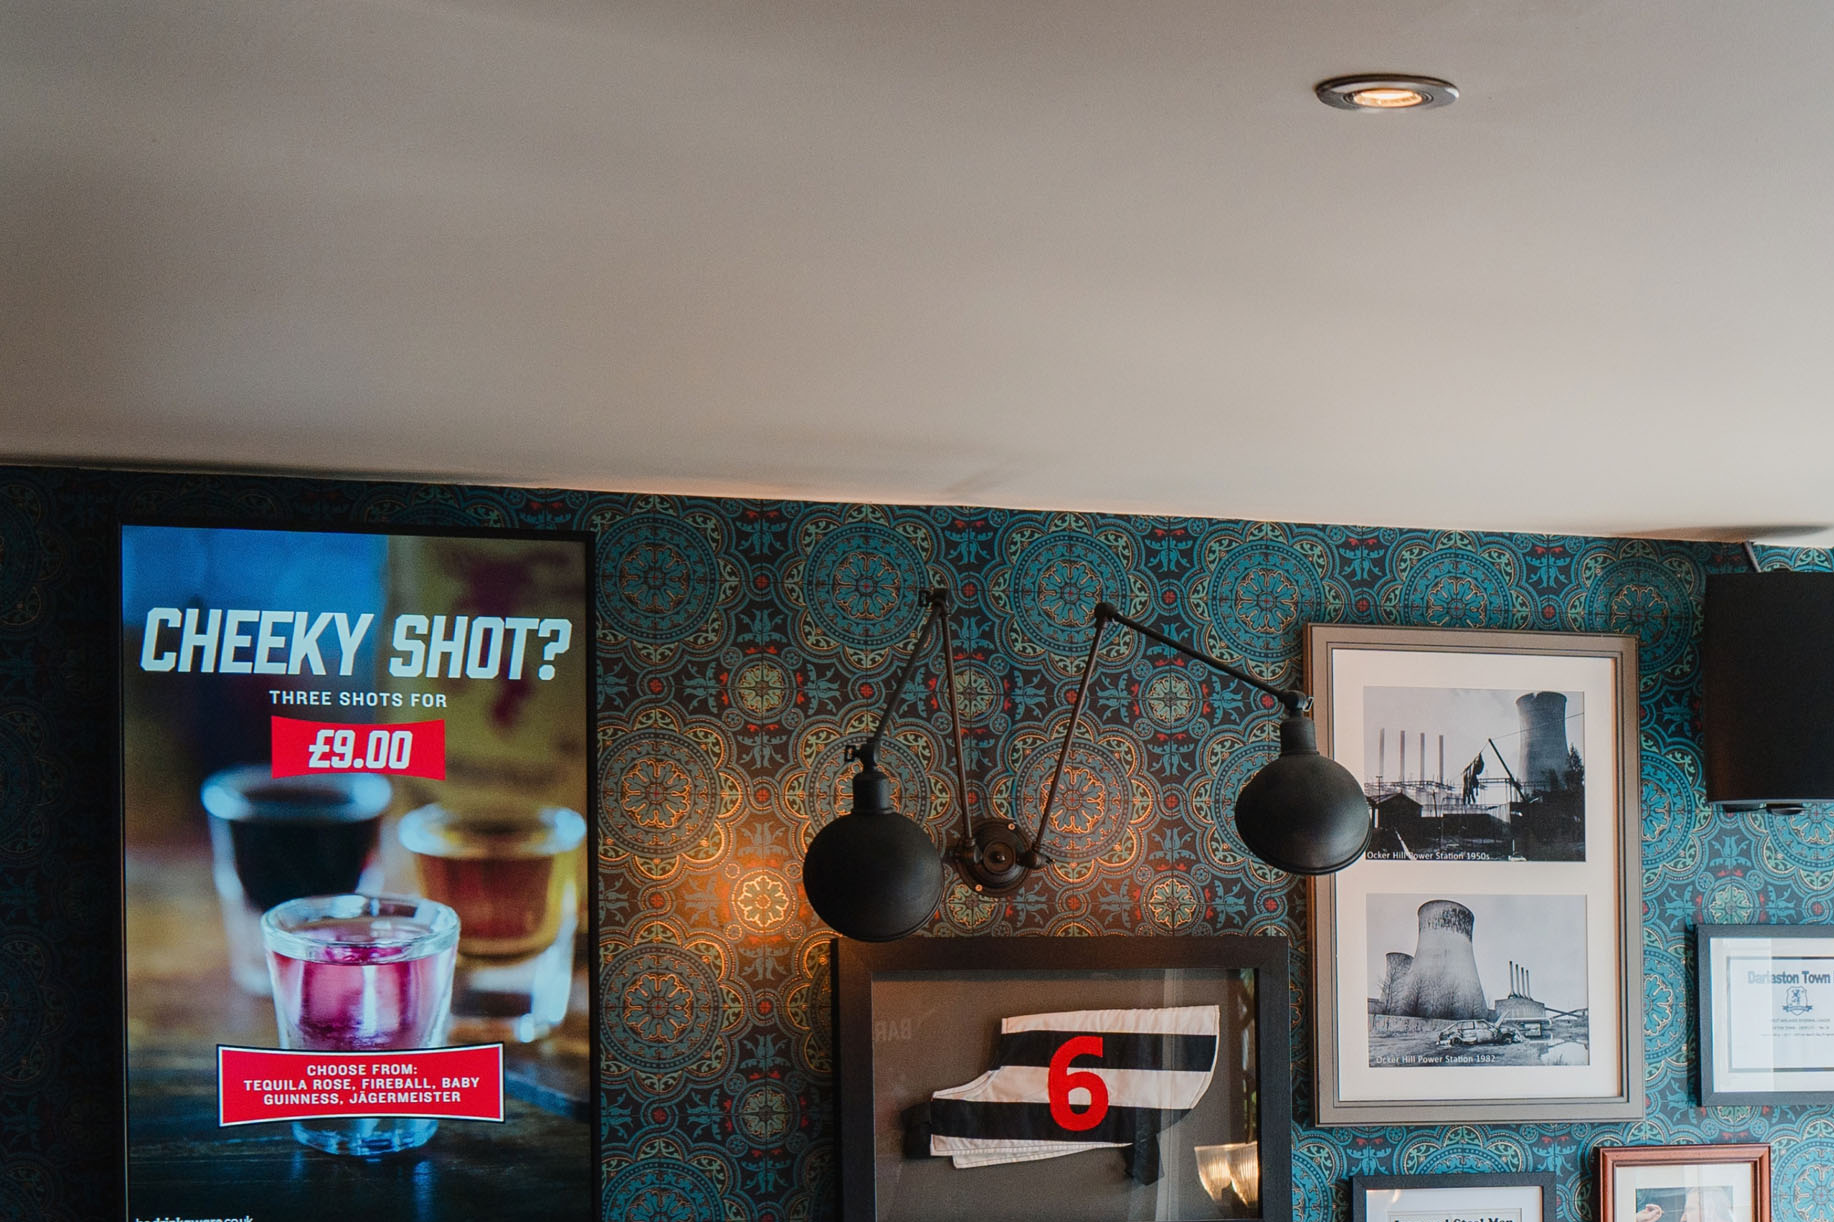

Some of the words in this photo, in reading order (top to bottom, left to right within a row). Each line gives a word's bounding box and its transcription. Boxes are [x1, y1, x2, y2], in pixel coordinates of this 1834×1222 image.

[140, 607, 375, 676] CHEEKY
[388, 614, 572, 680] SHOT?
[269, 690, 332, 706] THREE
[339, 691, 403, 708] SHOTS
[411, 693, 448, 708] FOR
[308, 729, 413, 770] £9.00
[1367, 851, 1390, 860] Ocker
[1392, 851, 1406, 860] Hill
[1435, 851, 1464, 860] Station
[1466, 852, 1490, 861] 1950s
[1801, 970, 1831, 984] Town
[1375, 1055, 1400, 1064] Ocker
[1402, 1055, 1416, 1064] Hill
[1418, 1055, 1443, 1064] Power
[1445, 1055, 1474, 1064] Station
[1476, 1054, 1496, 1063] 1982
[307, 1064, 367, 1077] CHOOSE
[371, 1063, 418, 1076] FROM:
[243, 1079, 308, 1092] TEQUILA
[313, 1078, 357, 1092] ROSE,
[361, 1077, 437, 1091] FIREBALL,
[441, 1077, 480, 1089] BABY
[1048, 1035, 1109, 1131] 6
[263, 1092, 344, 1106] GUINNESS,
[349, 1090, 462, 1105] JÄGERMEISTER
